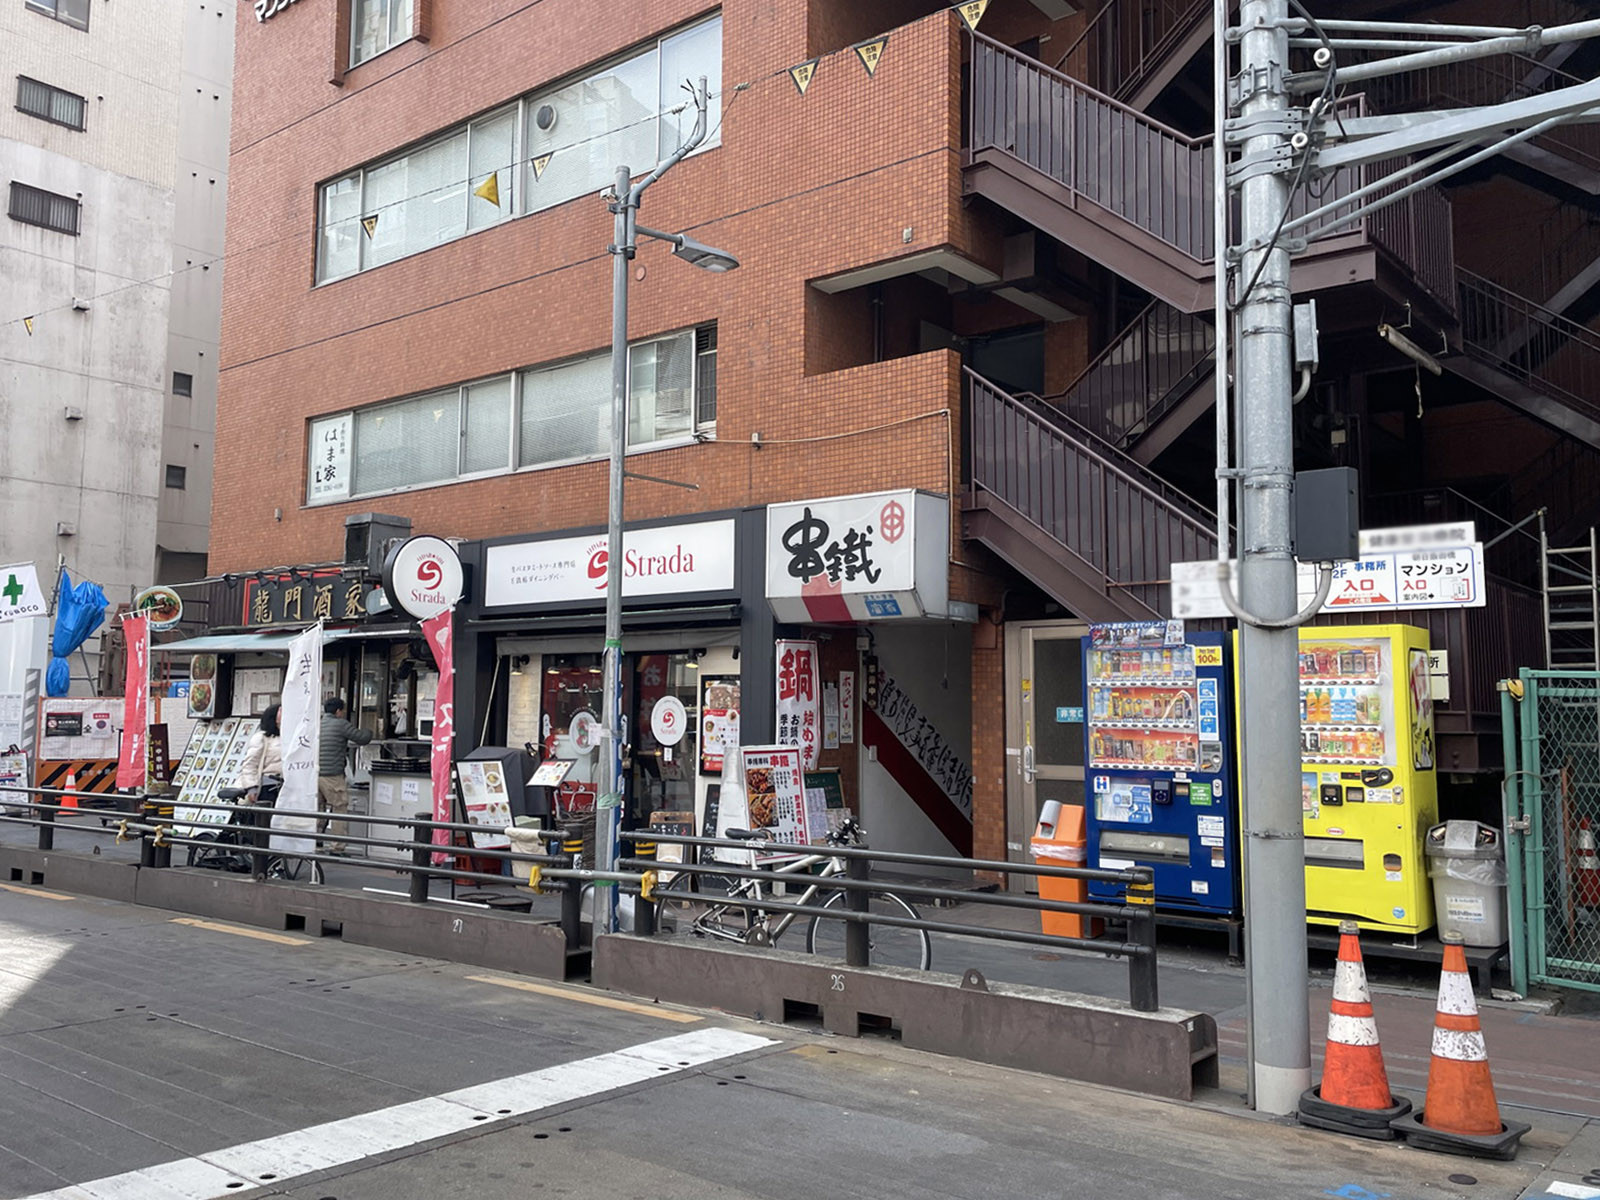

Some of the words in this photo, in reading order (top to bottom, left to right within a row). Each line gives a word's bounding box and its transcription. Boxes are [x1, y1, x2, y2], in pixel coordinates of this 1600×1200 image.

[324, 428, 338, 482] はま家
[624, 544, 695, 578] Strada
[1354, 560, 1386, 572] 事務所
[1400, 562, 1469, 577] マンション
[1332, 568, 1348, 579] 2F
[1343, 578, 1375, 593] 入口
[1402, 579, 1427, 591] 入口
[252, 580, 368, 623] 龍門酒家
[410, 589, 447, 605] Strada
[778, 648, 814, 703] 鍋
[842, 676, 852, 722] ホッピー
[830, 974, 845, 992] 26
